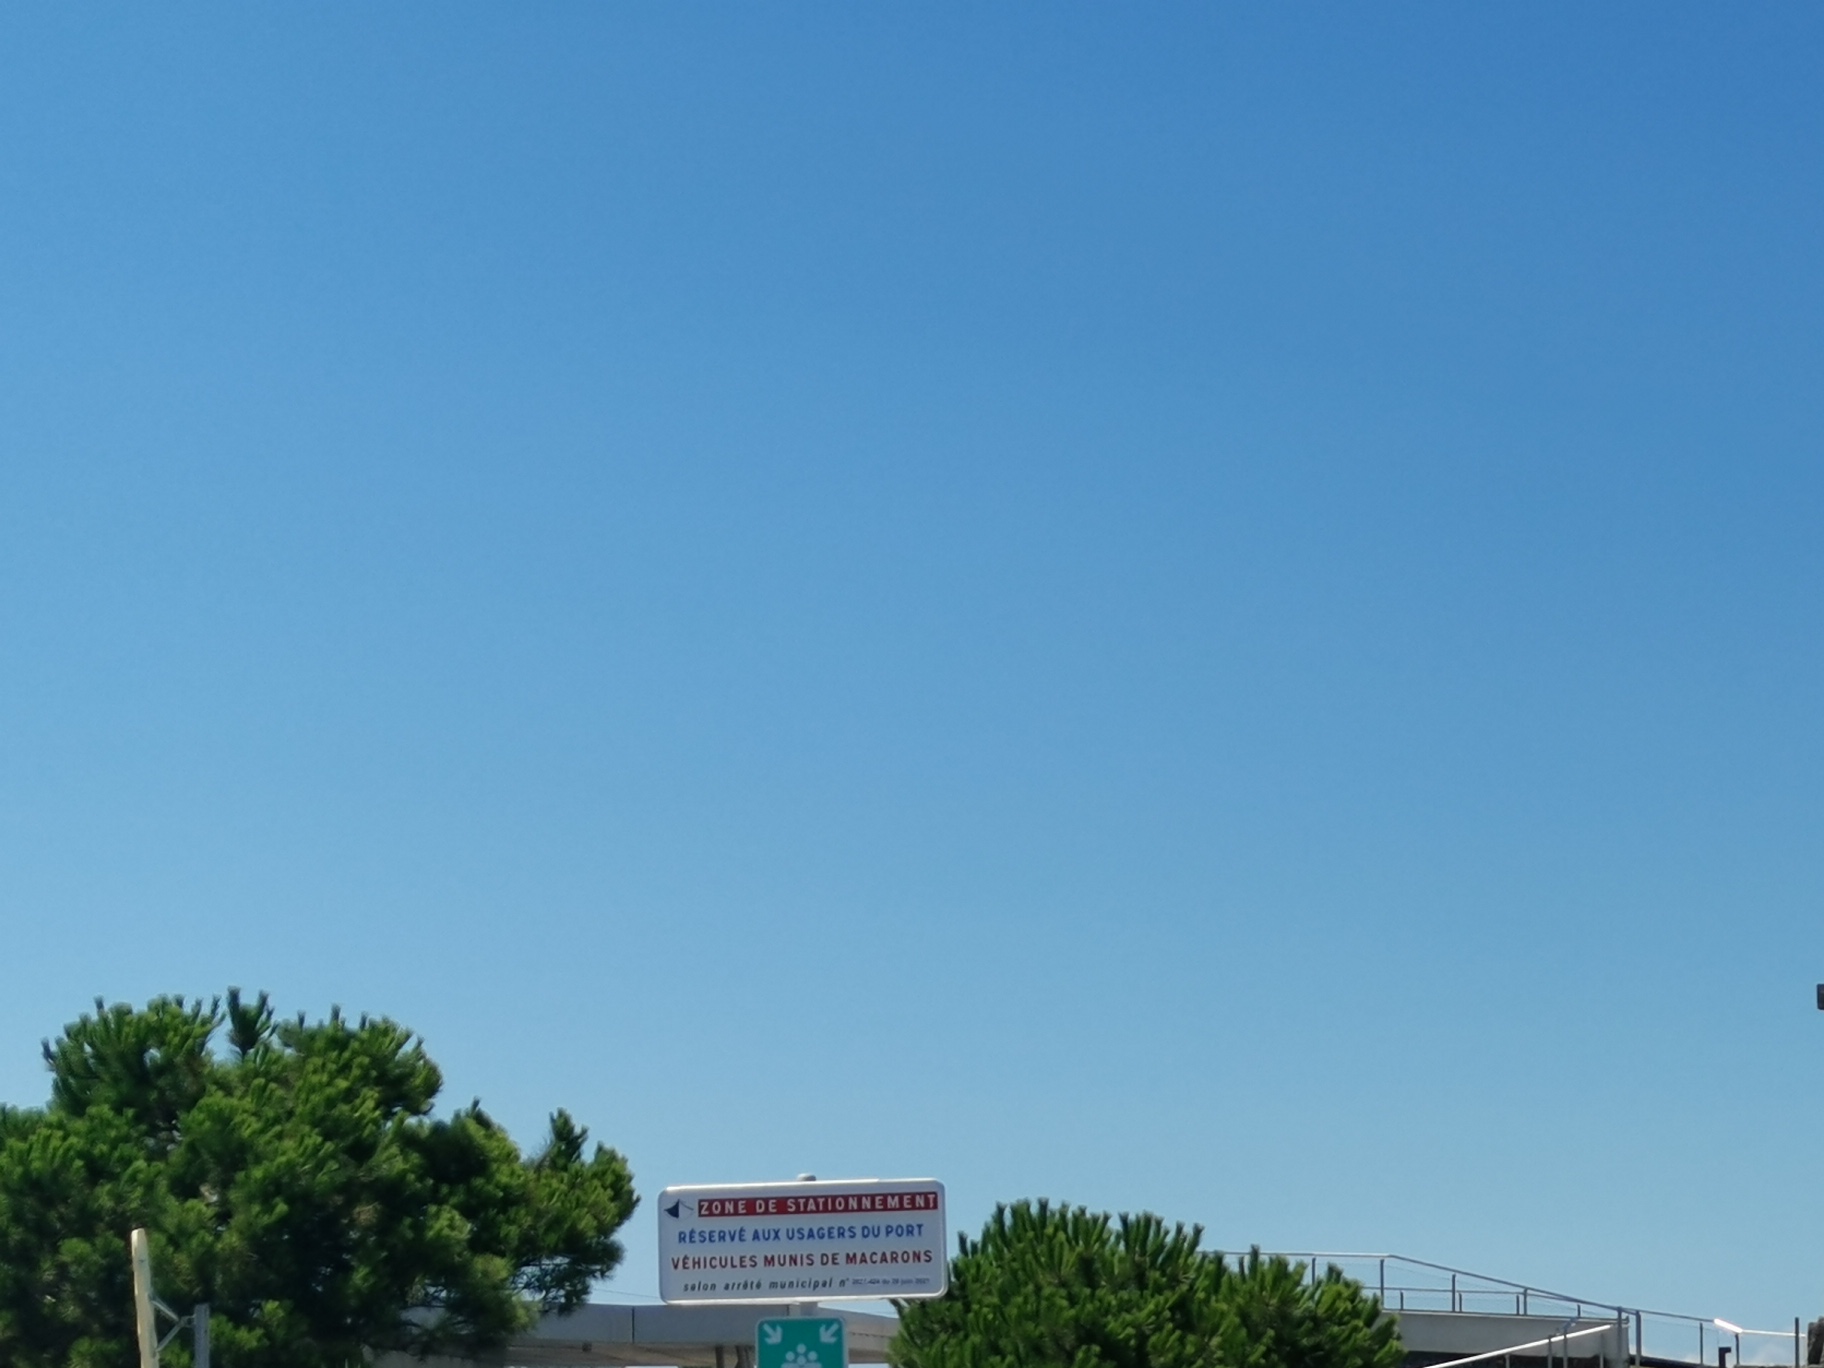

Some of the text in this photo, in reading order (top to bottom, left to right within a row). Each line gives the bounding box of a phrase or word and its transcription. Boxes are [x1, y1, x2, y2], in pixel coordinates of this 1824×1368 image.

[700, 1194, 936, 1215] ZONE DE STATIONNEMENT
[678, 1223, 924, 1244] RÉSERVÉ AUX USAGERS DU PORT
[671, 1249, 933, 1271] VÉHICULES MUNIS DE MACARONS
[683, 1281, 717, 1292] selon
[723, 1279, 762, 1291] arrêté
[768, 1277, 833, 1291] municipal
